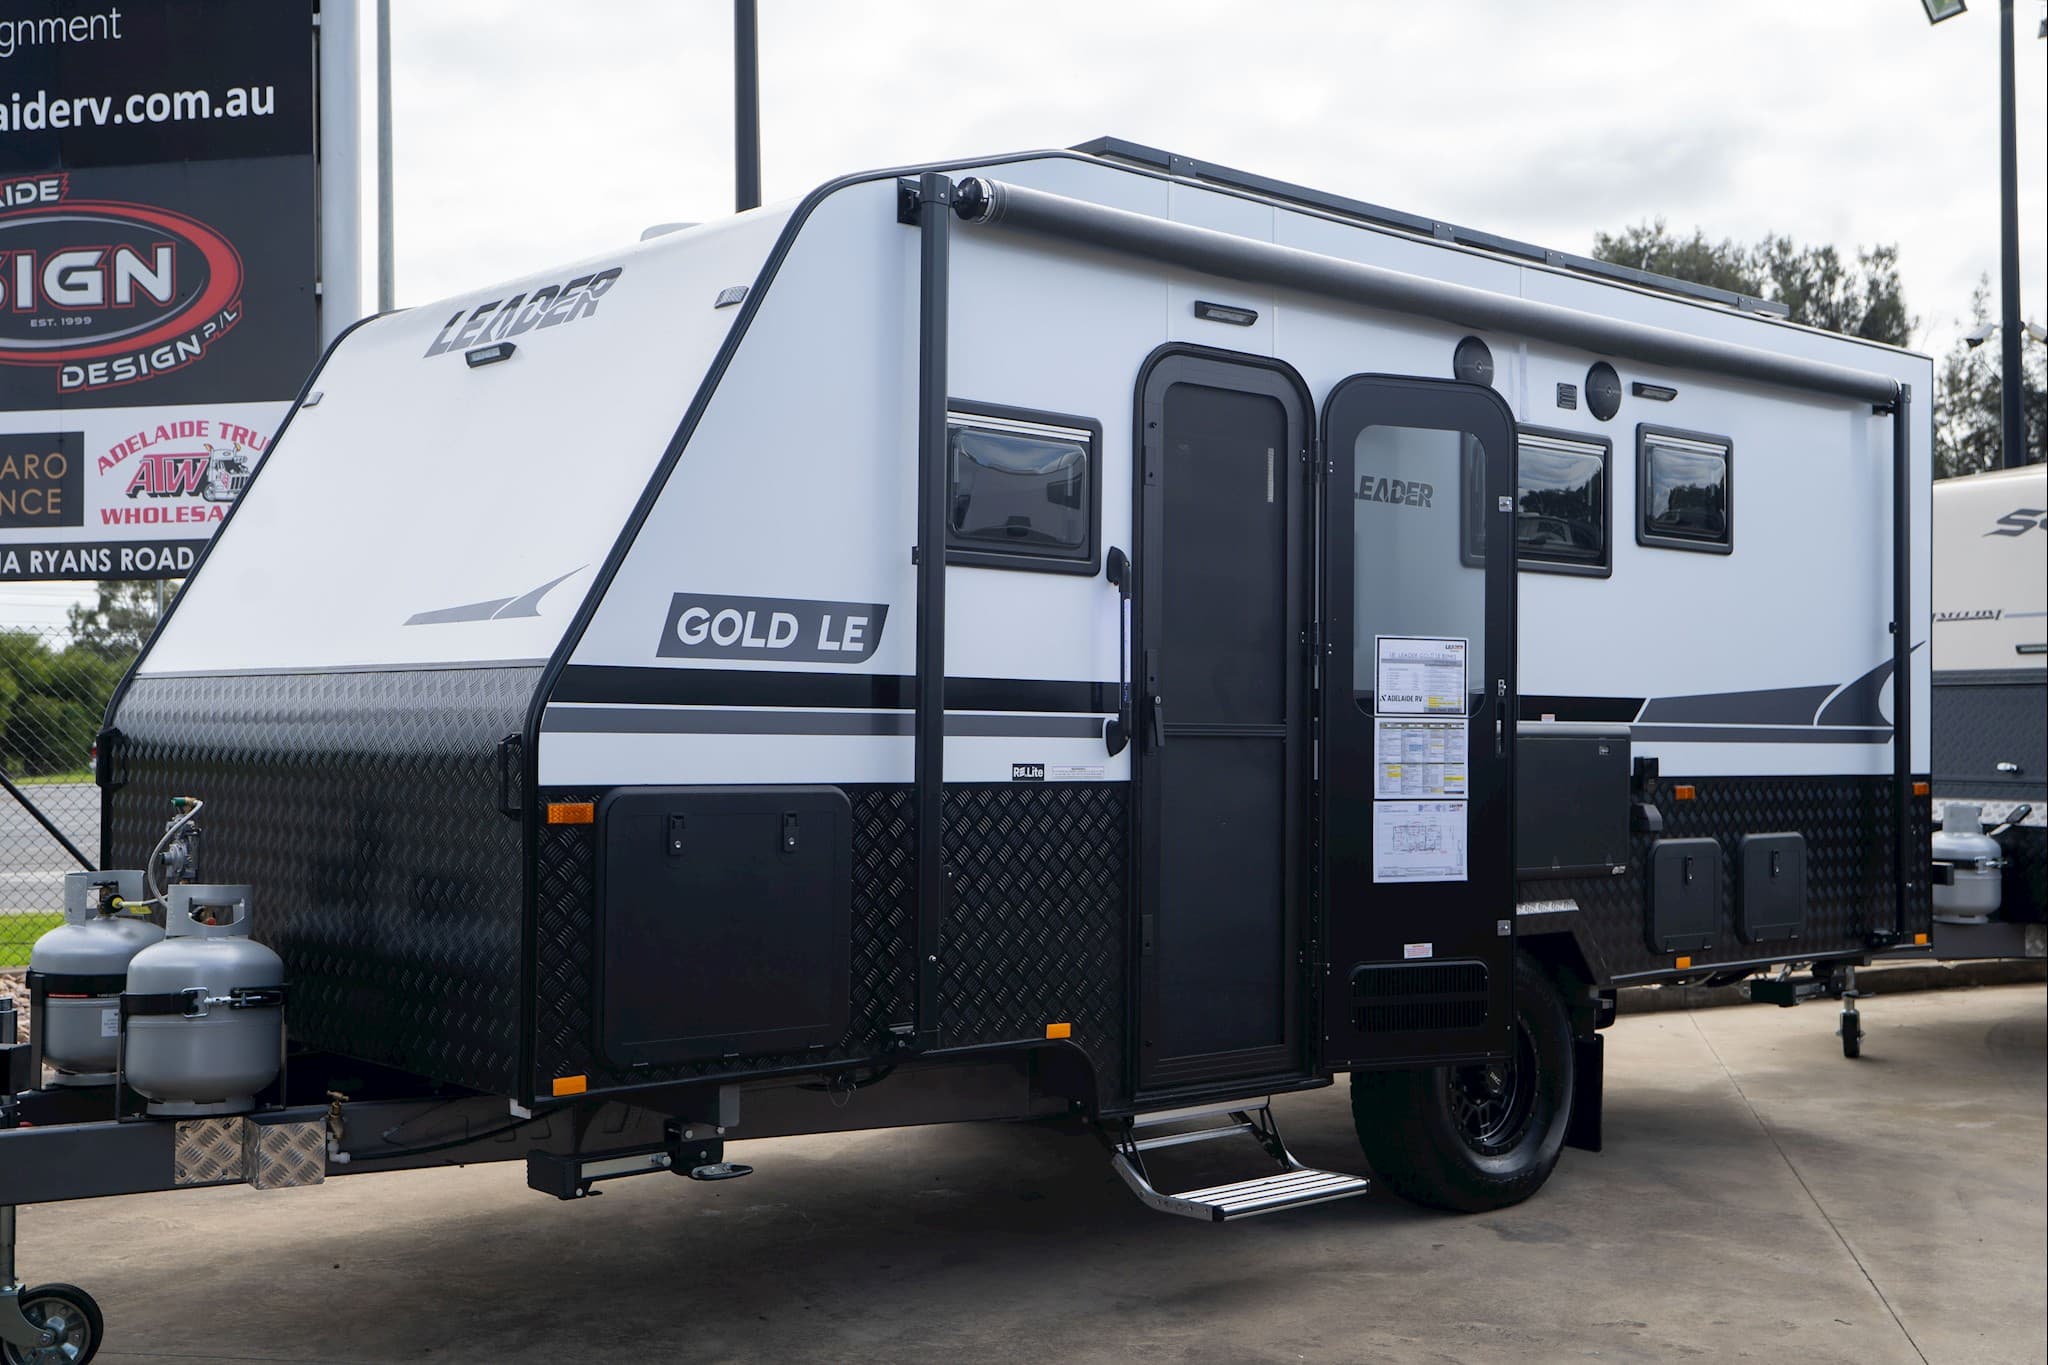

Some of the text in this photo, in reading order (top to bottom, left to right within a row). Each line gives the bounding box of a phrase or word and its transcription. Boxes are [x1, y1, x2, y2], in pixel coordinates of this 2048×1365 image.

[0, 7, 122, 58] gnment
[0, 179, 60, 208] IDE
[0, 246, 172, 308] IGN
[30, 316, 92, 328] EST. 1999
[422, 267, 623, 359] LEADER
[61, 309, 238, 388] DESIGN P/L
[0, 452, 68, 480] ARO
[97, 420, 271, 476] ADELAIDE TRU
[125, 452, 210, 498] ATW
[1354, 474, 1434, 508] EADER
[0, 488, 62, 516] NCE
[100, 505, 232, 525] WHOLESA
[0, 546, 195, 574] A RYANS ROAD
[676, 606, 869, 652] GOLD LE
